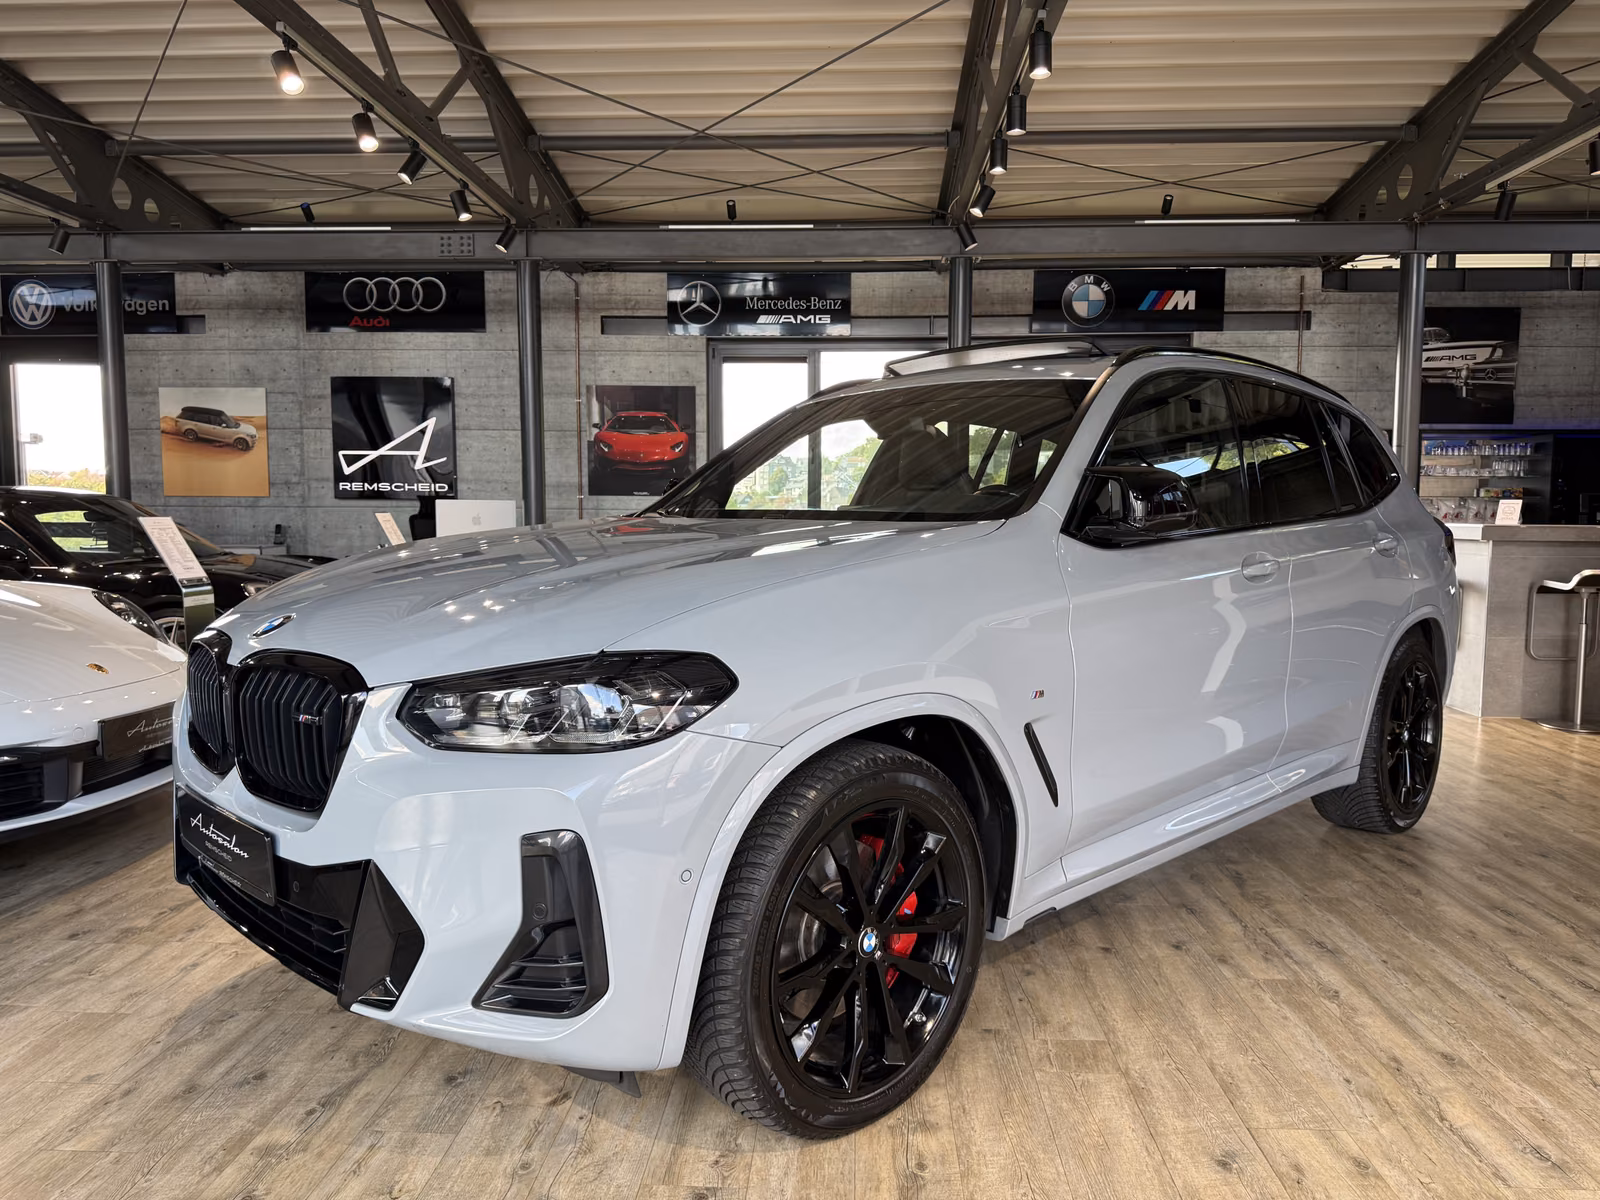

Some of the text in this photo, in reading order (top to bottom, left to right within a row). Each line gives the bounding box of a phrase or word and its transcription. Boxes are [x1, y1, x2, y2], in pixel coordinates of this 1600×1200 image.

[1067, 275, 1111, 293] BMW
[63, 296, 169, 315] Volkagen
[745, 296, 842, 310] Mercedes-Benz
[350, 316, 390, 327] Audi
[338, 482, 449, 492] REMSCHEID
[190, 812, 250, 859] Autosalon
